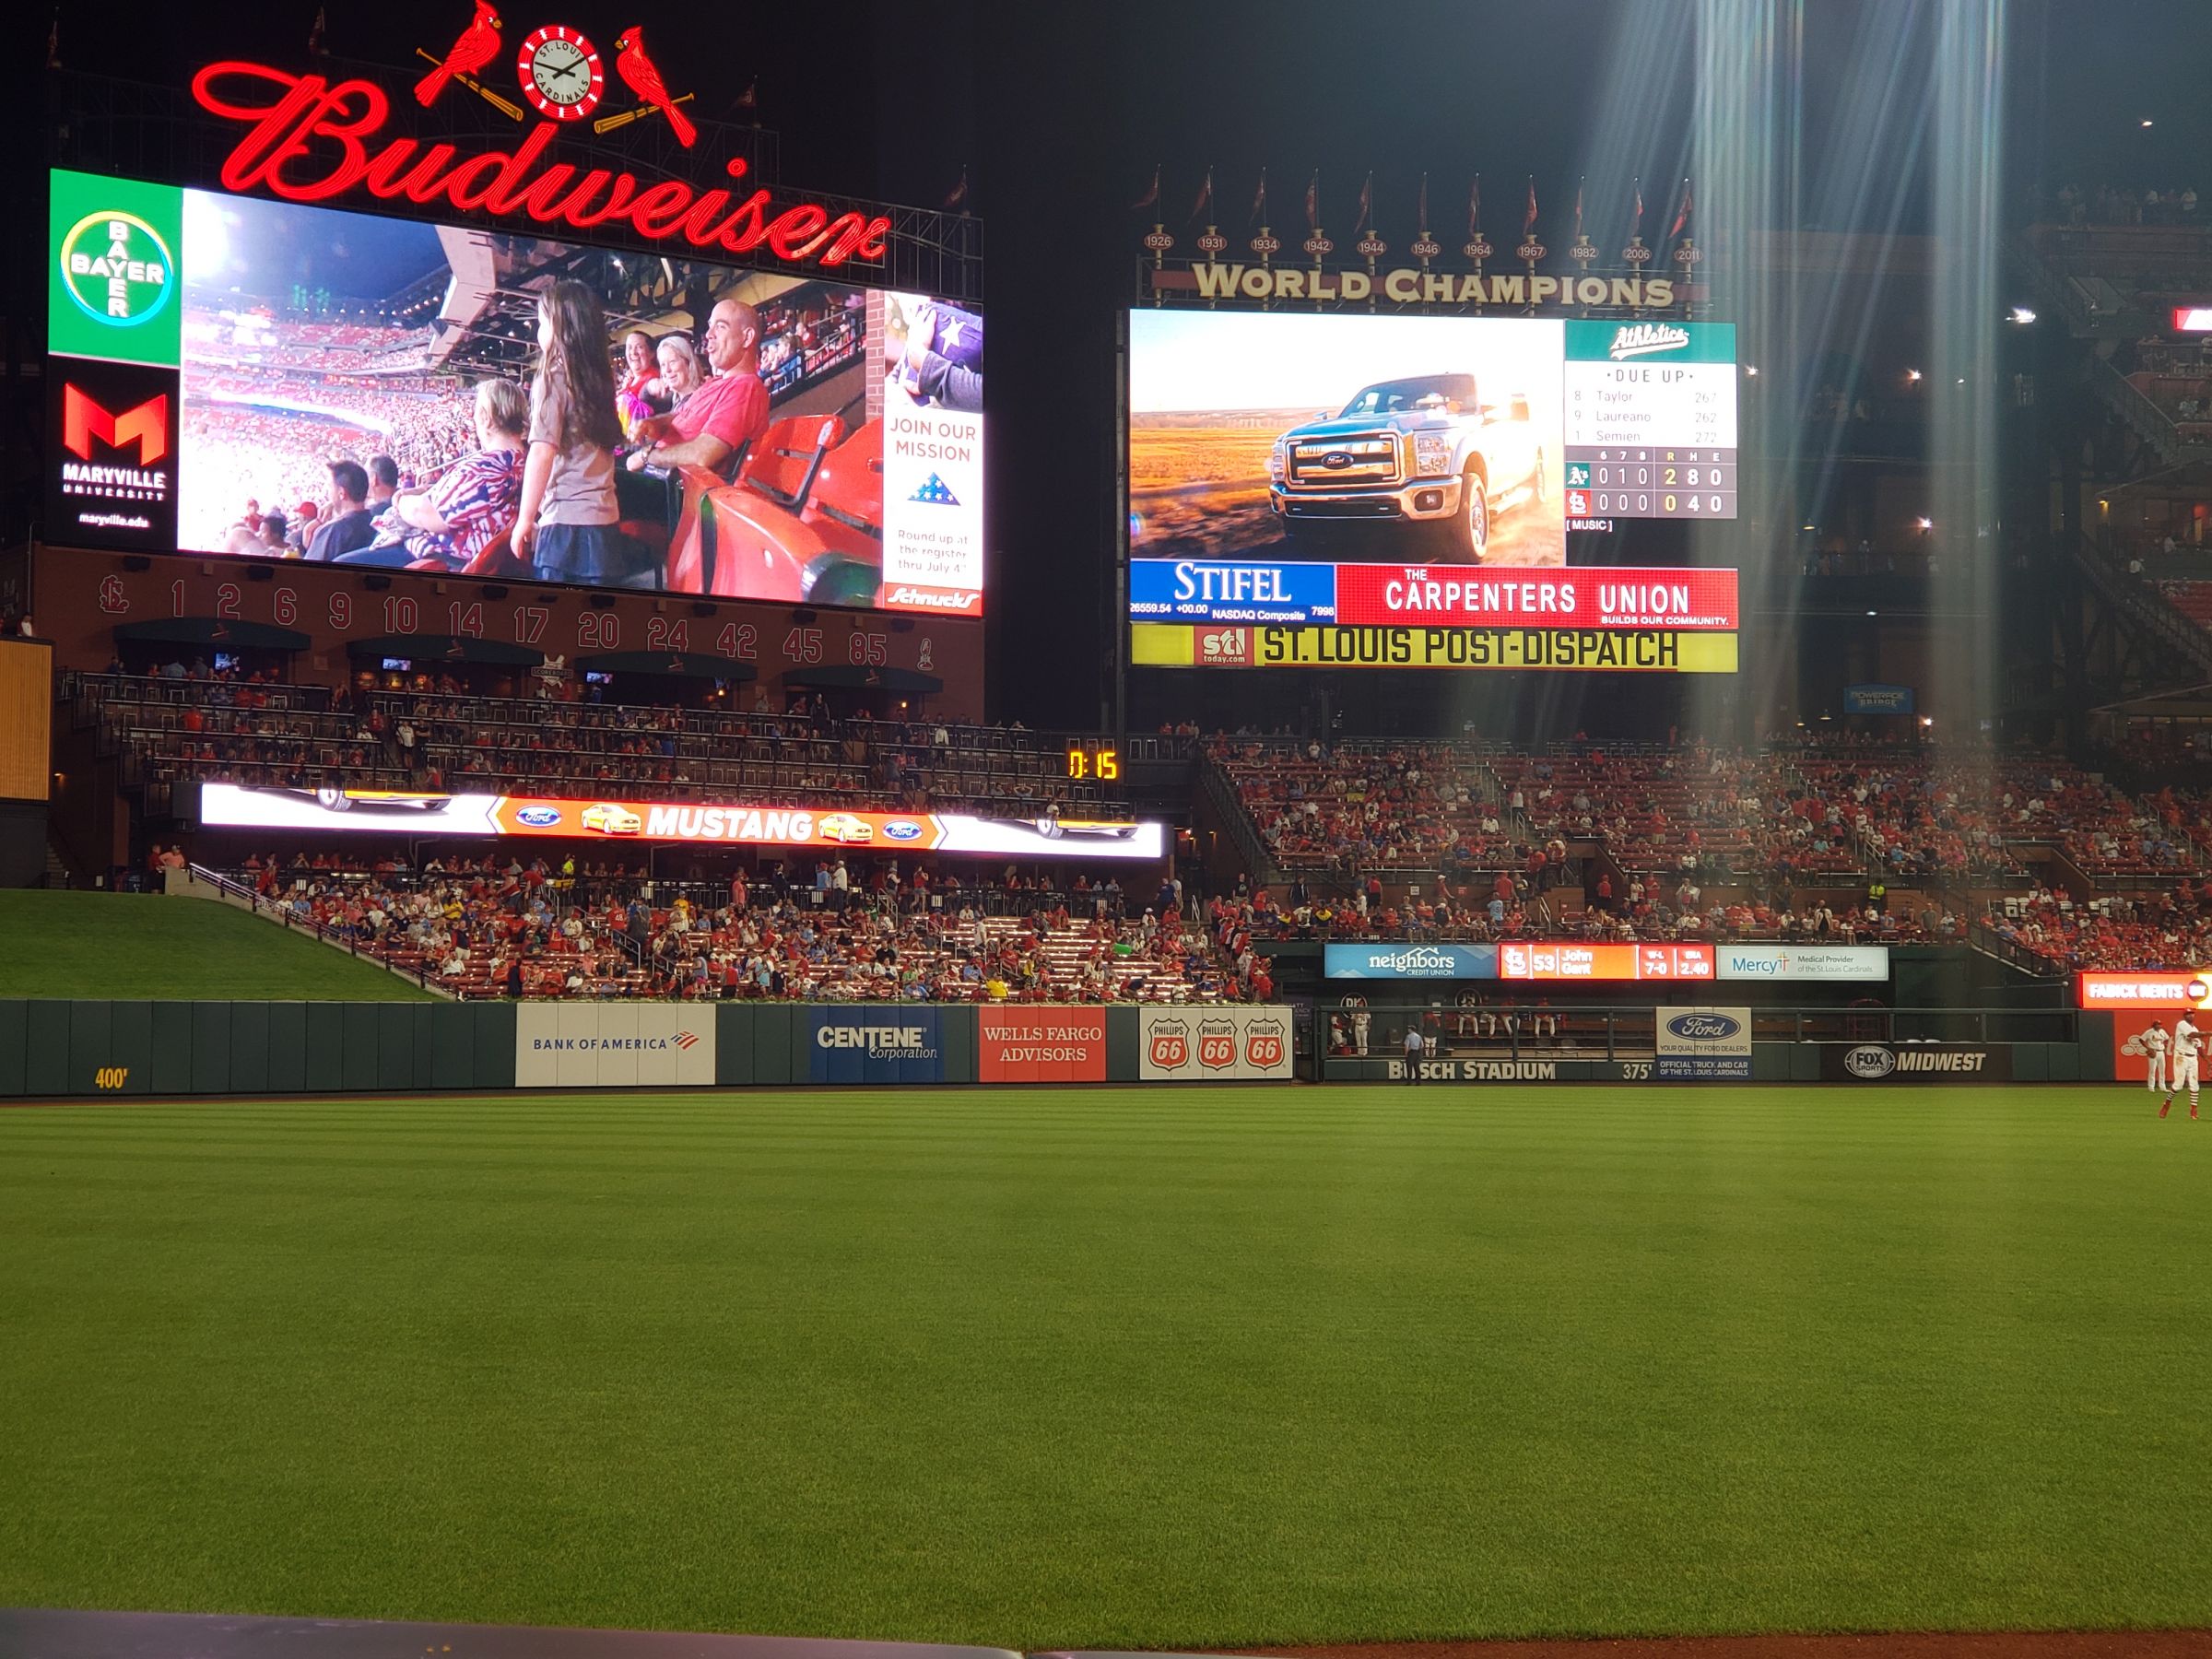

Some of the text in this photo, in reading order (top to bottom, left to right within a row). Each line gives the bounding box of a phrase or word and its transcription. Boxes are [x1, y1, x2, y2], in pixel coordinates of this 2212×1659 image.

[538, 41, 584, 59] ST. LOUI
[535, 72, 589, 102] CARDINALS
[192, 63, 891, 267] Budweiser
[1147, 236, 1700, 261] 1926 1931 1934 1942 1944 1946 1964 1967 1982 2006 2011
[71, 253, 165, 284] BAYER
[1192, 263, 1675, 308] WORLD CHAMPIONS
[1609, 323, 1689, 350] Athletics
[1616, 369, 1684, 382] DUE UP
[1574, 390, 1582, 401] 8
[1596, 390, 1633, 404] Taylor
[1574, 410, 1582, 420] 9
[1596, 410, 1652, 422] Laureano
[889, 418, 976, 441] JOIN OUR
[1575, 430, 1581, 441] 1
[1596, 430, 1641, 441] Semien
[896, 440, 971, 462] MISSION
[1599, 451, 1720, 462] 6 7 8 R H E
[63, 463, 167, 489] MARYVILLE
[1599, 467, 1608, 484] 0
[1618, 468, 1626, 484] 1
[1638, 468, 1648, 485] 0
[1665, 468, 1677, 485] 2
[1688, 469, 1699, 486] 8
[1710, 469, 1722, 486] 0
[63, 484, 165, 501] UNIVERSITY
[1599, 494, 1722, 512] 0 0 0 0 4 0
[79, 512, 150, 529] maryville.edu
[1571, 520, 1608, 531] MUSIC
[898, 529, 935, 542] Round
[940, 535, 954, 545] up
[900, 545, 967, 559] the register
[899, 559, 950, 573] thru July
[1174, 561, 1292, 602] STIFEL
[1405, 569, 1428, 581] THE
[887, 587, 981, 609] Schnucks
[1385, 581, 1688, 614] CARPENTERS UNION
[171, 579, 887, 667] 1 2 6 9 10 14 17 20 24 42 45 85
[1212, 609, 1306, 622] NASDAQ Composite
[1601, 616, 1729, 626] BUILDS OUR COMMUNITY.
[1203, 628, 1245, 655] stl
[1265, 627, 1678, 666] ST. LOUIS POST-DISPATCH
[1203, 655, 1245, 664] today.com
[524, 806, 914, 841] Ford MUSTANG Ford
[1369, 947, 1455, 972] neighbors
[1533, 955, 1555, 971] 53
[1561, 949, 1593, 962] John
[1646, 962, 1709, 975] 7-0 2.40
[1733, 958, 1778, 975] Mercy
[983, 1027, 1102, 1041] WELLS FARGO
[1154, 1026, 1183, 1035] PHILLIPS
[1202, 1026, 1231, 1035] PHILLIPS
[1250, 1026, 1279, 1035] PHILLIPS
[1681, 1017, 1726, 1036] Ford
[534, 1039, 667, 1050] BANK OF AMERICA
[817, 1026, 924, 1049] CENTENE
[868, 1046, 938, 1062] Corporation
[999, 1048, 1088, 1062] ADVISORS
[1156, 1041, 1182, 1060] 66
[1204, 1041, 1230, 1060] 66
[1252, 1041, 1277, 1060] 66
[1855, 1053, 1884, 1065] FOX
[1463, 1061, 1557, 1080] STADIUM
[1734, 1061, 1748, 1069] CAR
[1896, 1052, 1987, 1072] MIDWEST
[95, 1067, 128, 1089] 400'
[1623, 1064, 1653, 1080] 375'
